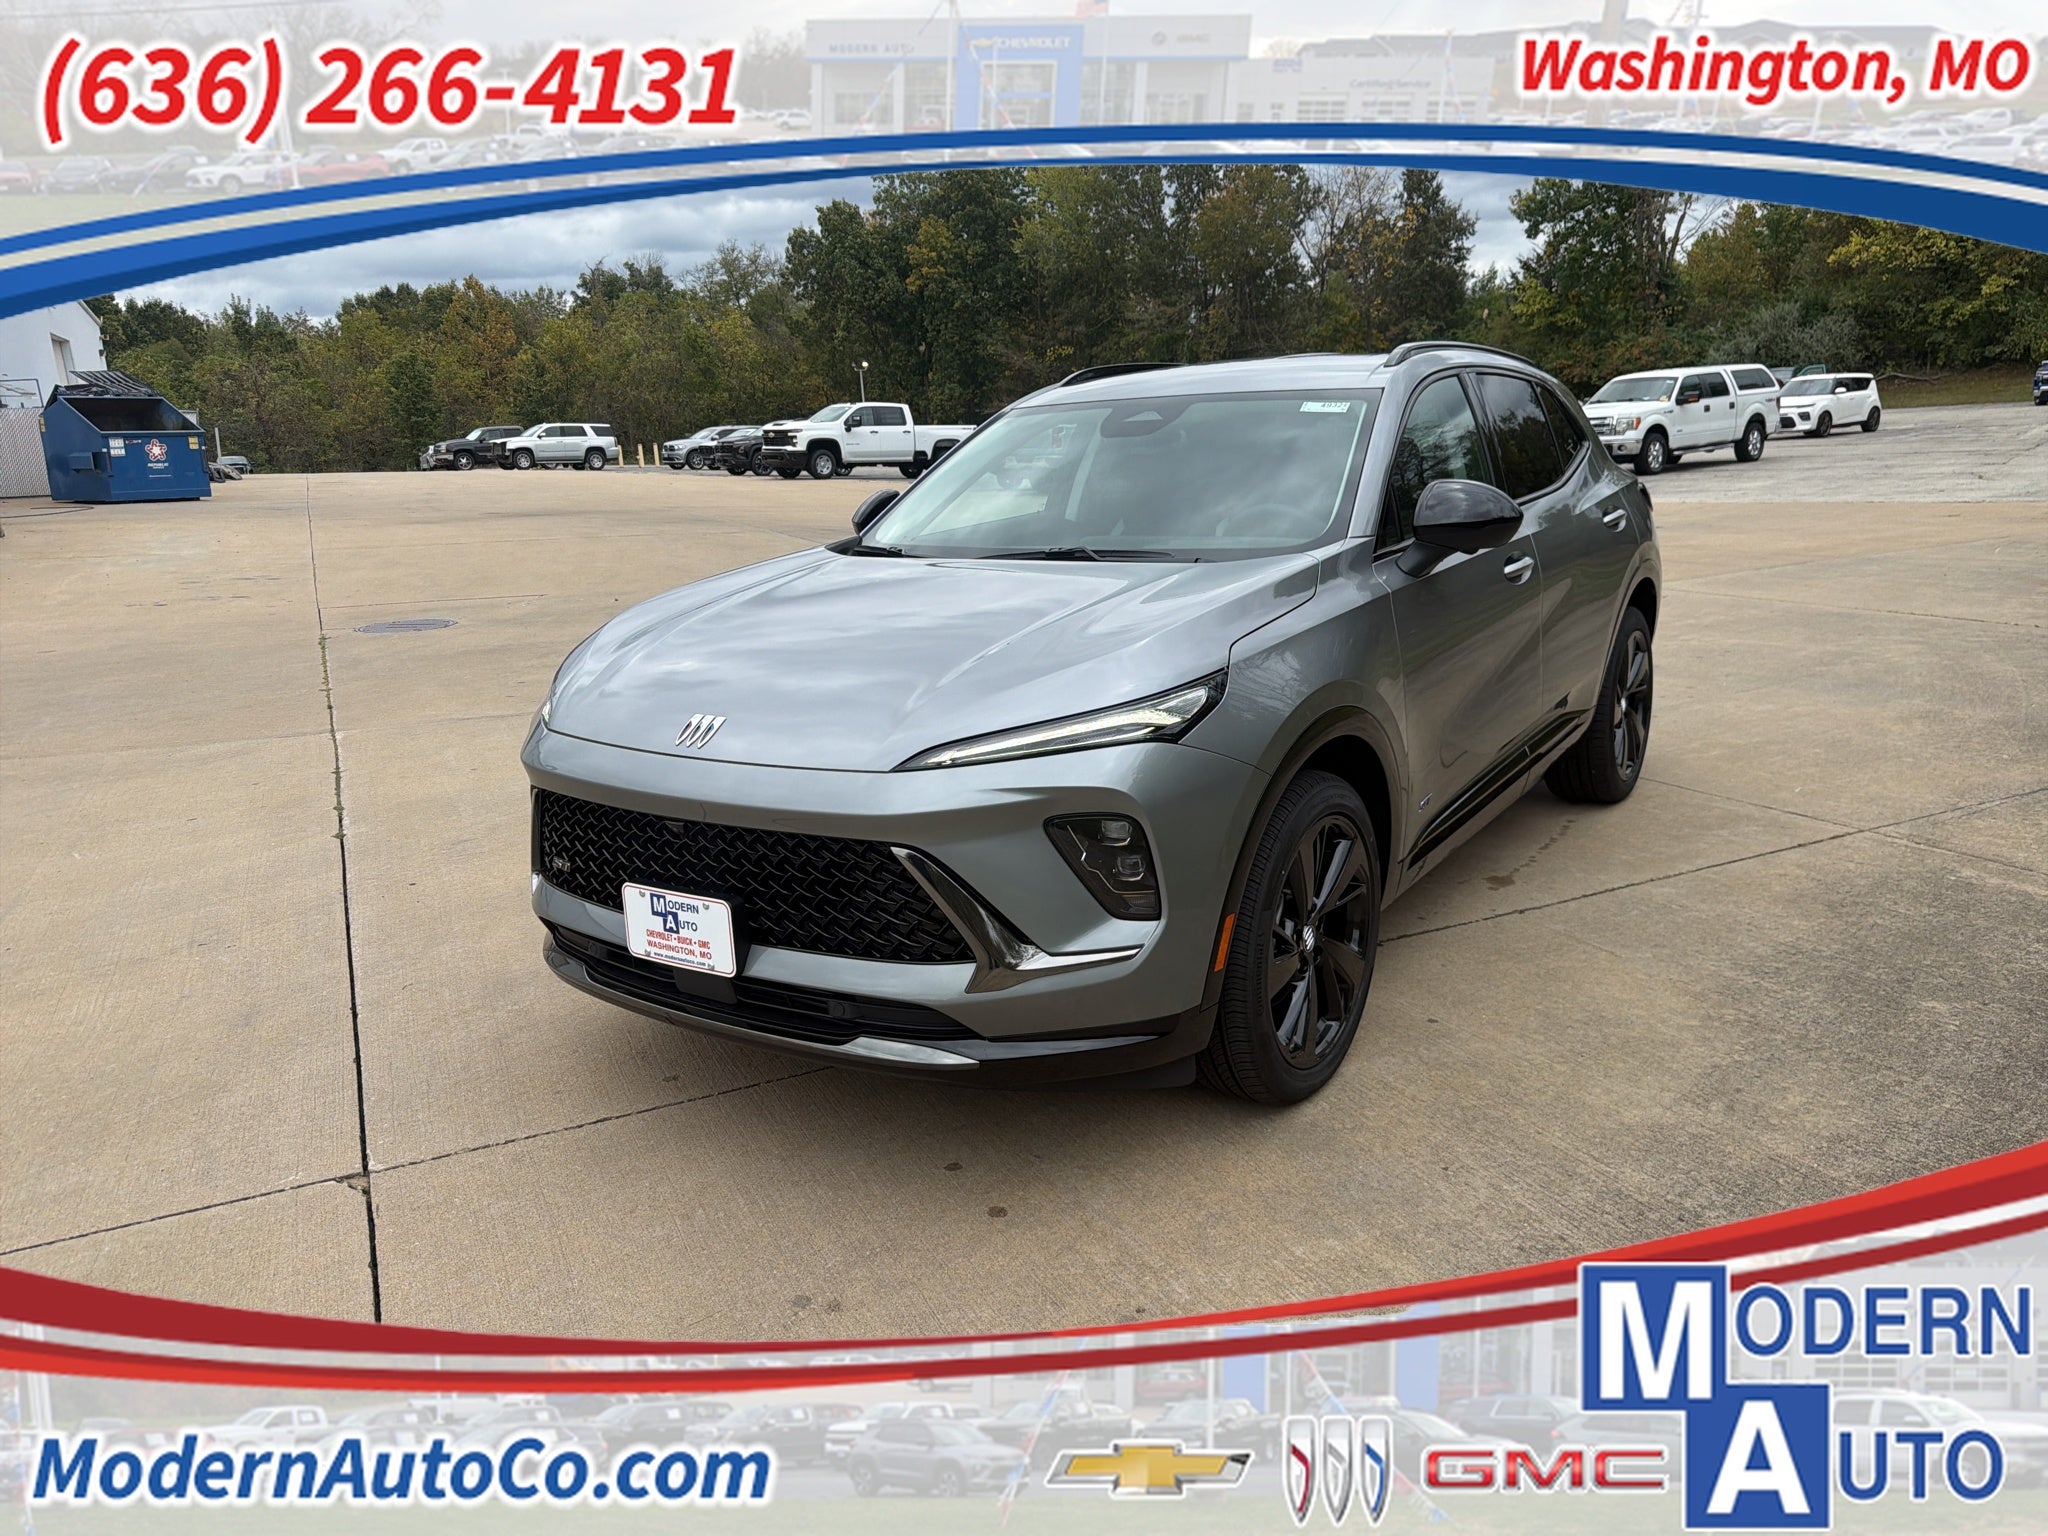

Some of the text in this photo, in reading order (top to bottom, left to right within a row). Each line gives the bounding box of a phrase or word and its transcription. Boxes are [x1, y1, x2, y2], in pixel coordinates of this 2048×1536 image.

[653, 896, 699, 915] MODERN
[666, 914, 698, 931] AUTO
[646, 928, 711, 950] CHEVROLET BUICK GMC
[647, 939, 712, 960] WASHINGTON, MO
